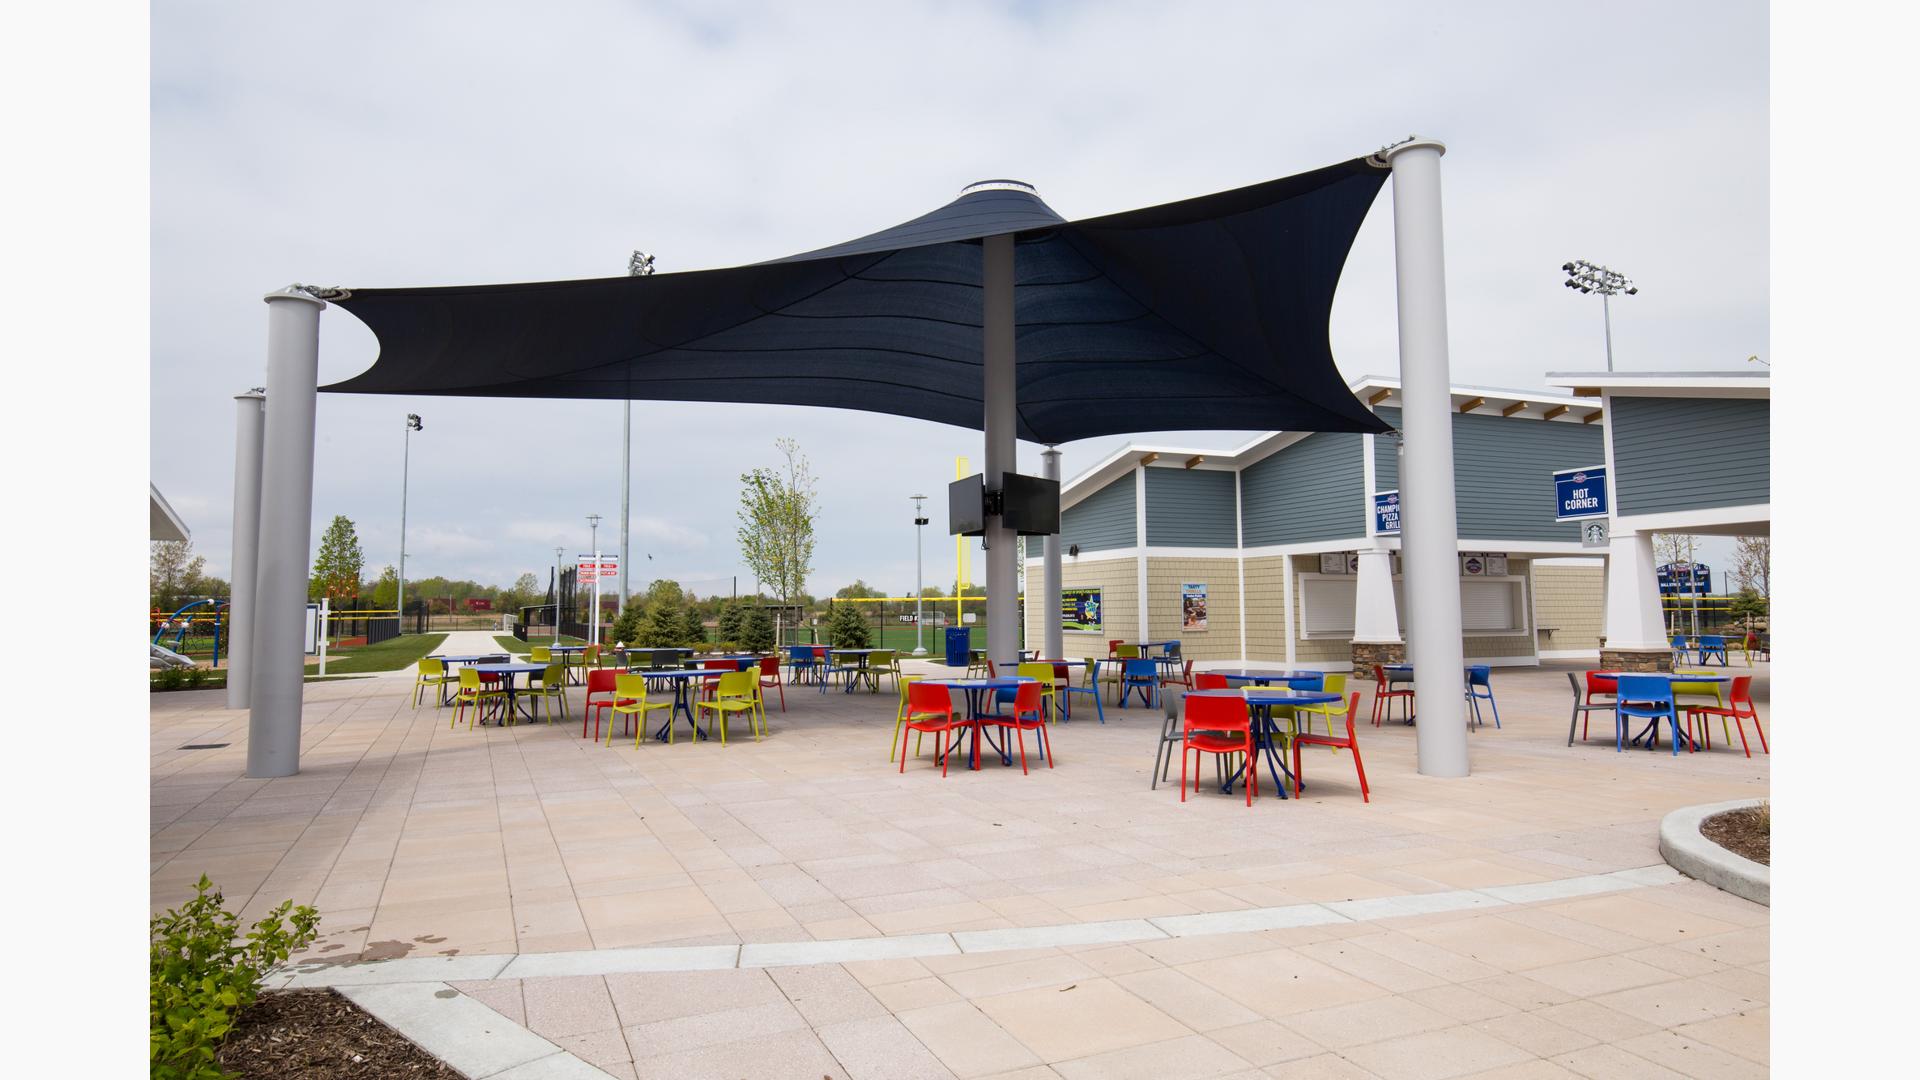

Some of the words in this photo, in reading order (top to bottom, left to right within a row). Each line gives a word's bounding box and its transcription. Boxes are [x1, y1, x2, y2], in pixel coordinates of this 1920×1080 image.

[1573, 488, 1589, 499] HOT
[1565, 498, 1598, 510] CORNER
[1382, 512, 1399, 522] PIZZA
